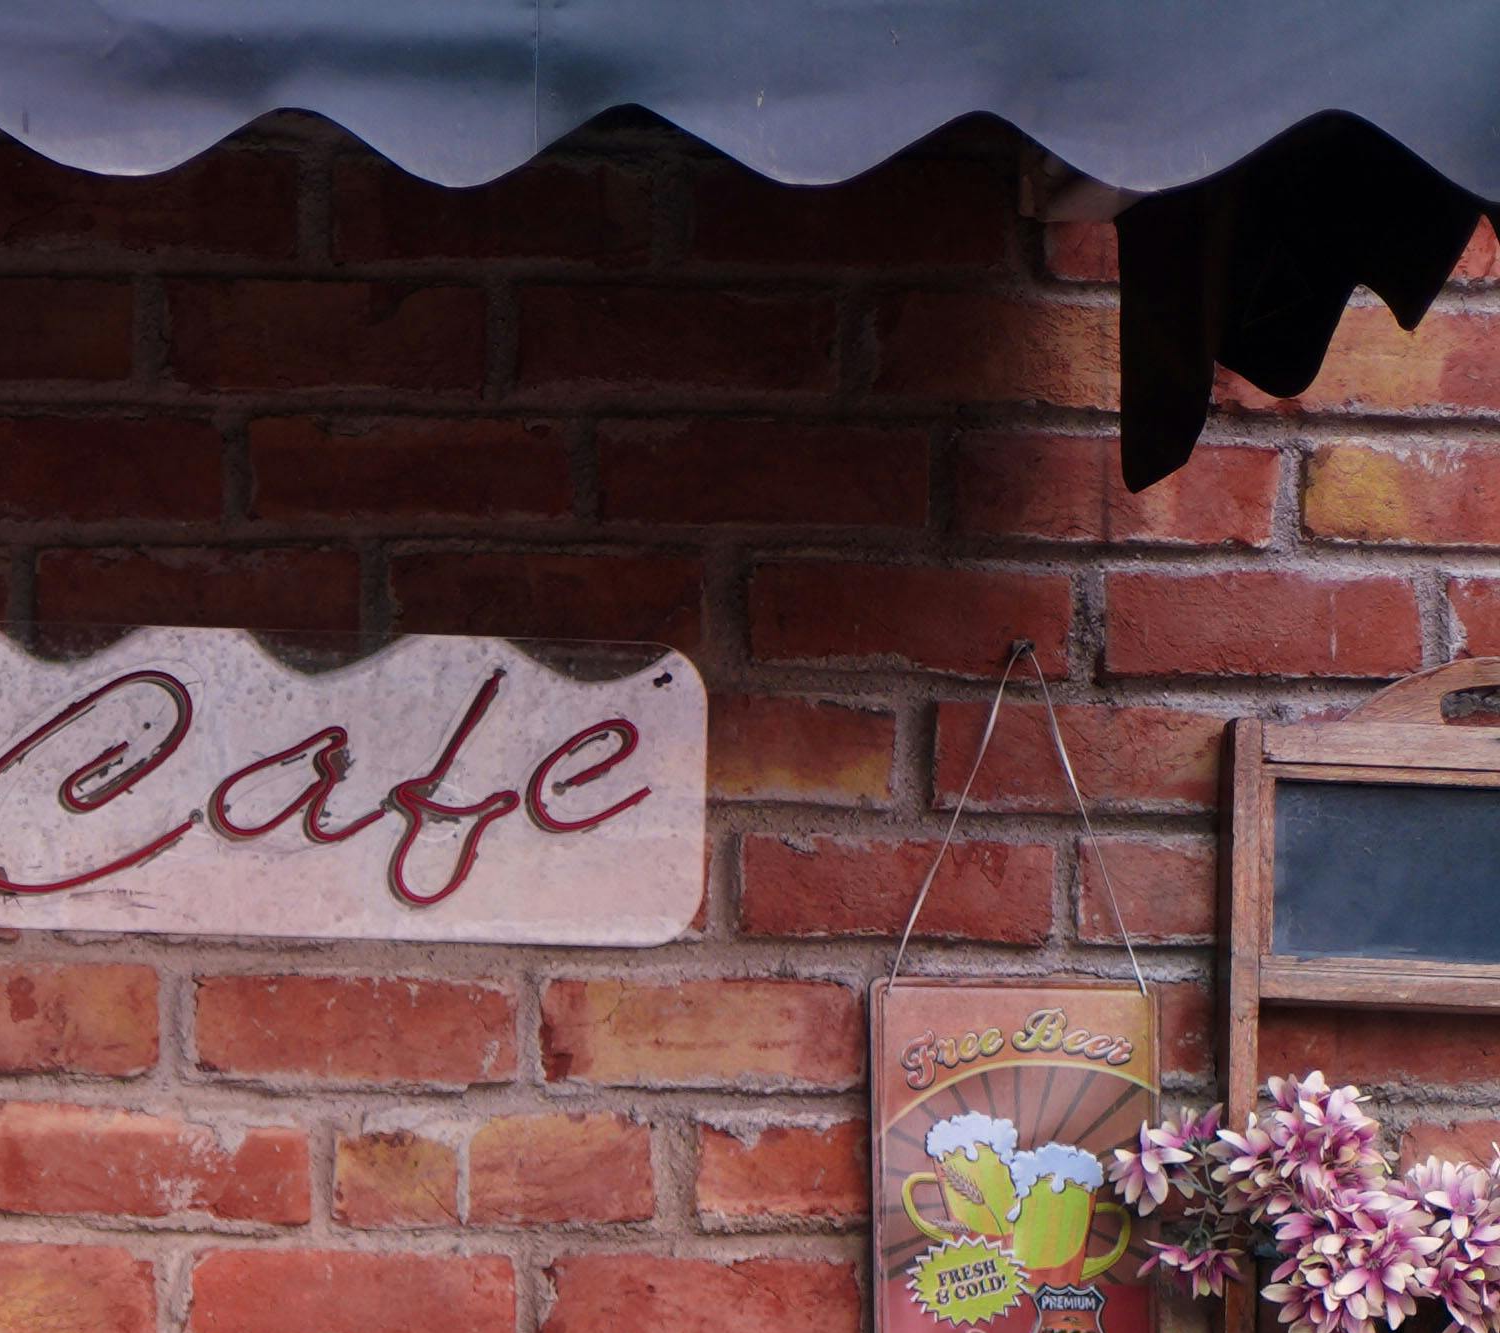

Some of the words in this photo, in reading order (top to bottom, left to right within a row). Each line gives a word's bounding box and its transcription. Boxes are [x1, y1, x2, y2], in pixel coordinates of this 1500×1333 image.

[901, 1028, 1005, 1090] Free
[1012, 1008, 1134, 1065] Beer
[937, 1259, 997, 1287] FRESH
[936, 1288, 950, 1305] &
[955, 1274, 1008, 1300] COLD!
[1041, 1296, 1096, 1310] PREMIUM
